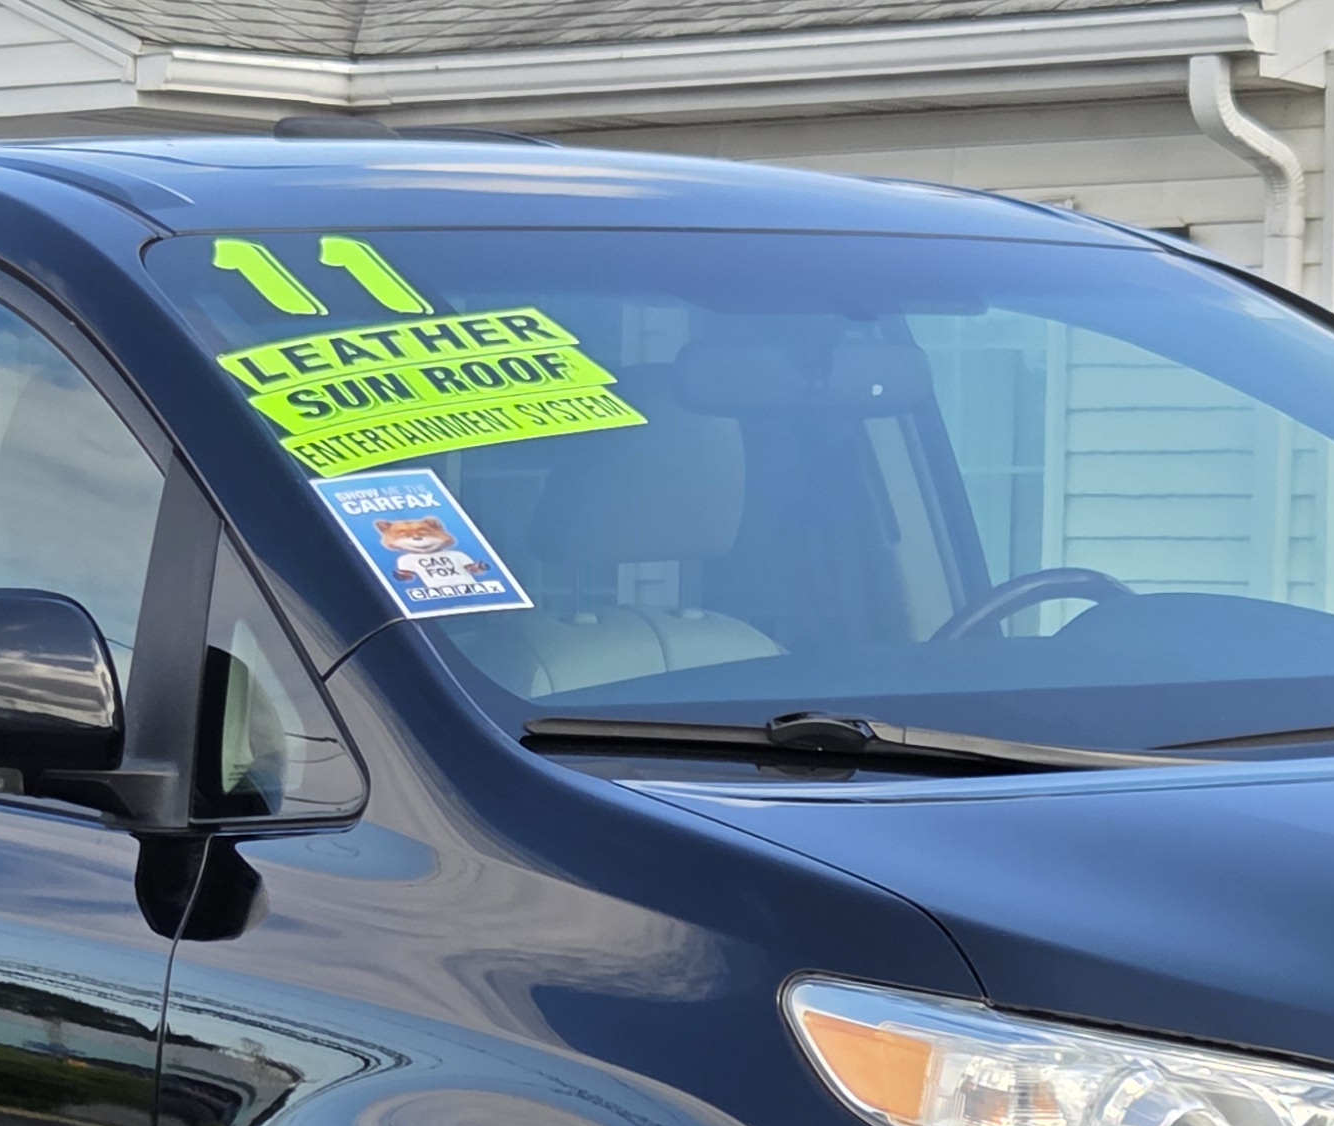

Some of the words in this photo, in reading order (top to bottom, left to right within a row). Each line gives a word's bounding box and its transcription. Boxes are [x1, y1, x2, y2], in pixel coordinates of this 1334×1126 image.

[212, 236, 434, 315] 11
[237, 314, 560, 386] LEATHER
[285, 371, 416, 420] SUN
[422, 352, 570, 395] ROOF
[293, 407, 523, 468] ENTERTAINMENT
[514, 393, 633, 426] SYSTEM
[334, 487, 380, 502] SHOW
[381, 486, 403, 496] ME
[403, 483, 429, 495] THE
[341, 492, 442, 516] CARFAX
[418, 556, 454, 569] CAR
[426, 566, 461, 578] FOX
